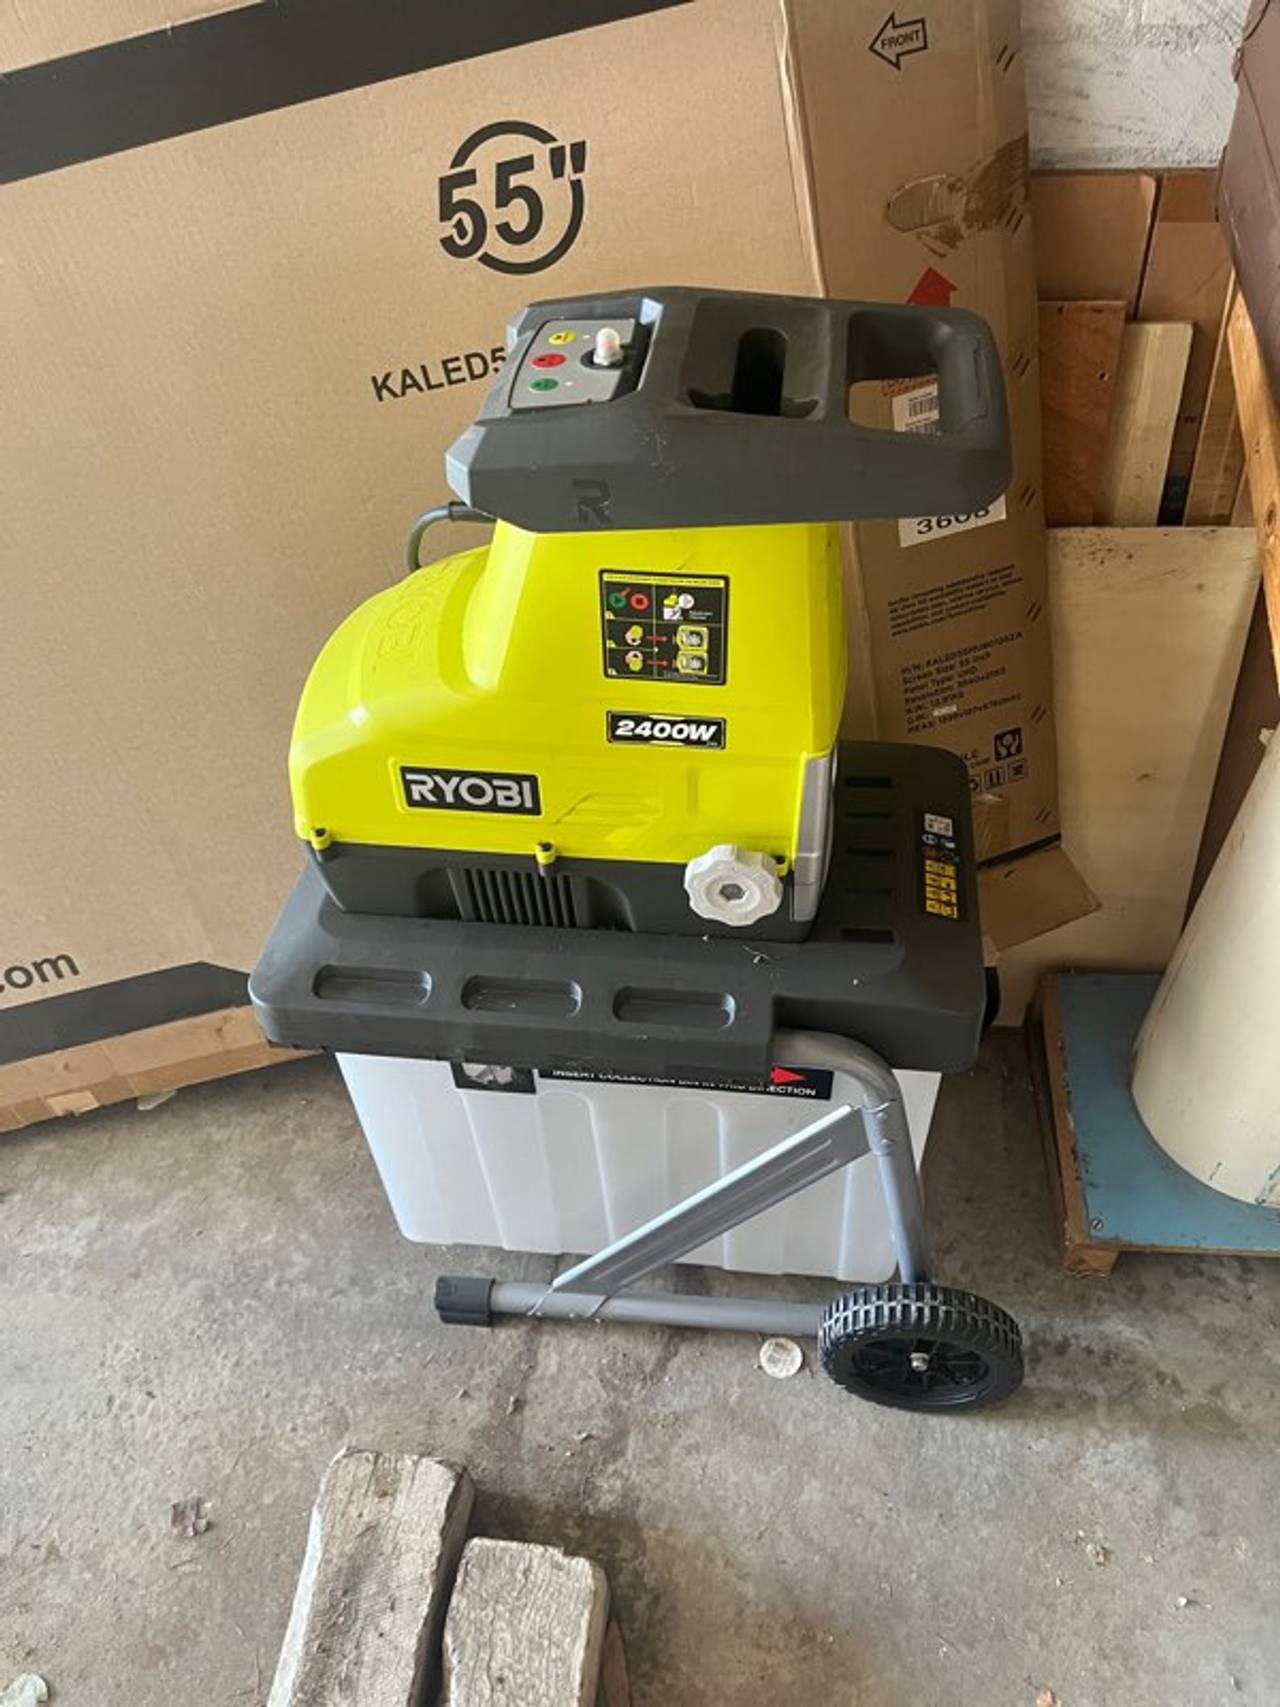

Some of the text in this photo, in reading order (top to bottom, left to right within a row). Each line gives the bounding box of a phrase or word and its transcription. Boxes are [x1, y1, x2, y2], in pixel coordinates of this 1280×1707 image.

[881, 30, 920, 49] FRONT
[439, 139, 586, 258] 55"
[614, 718, 718, 741] 2400W
[404, 772, 533, 808] RYOBI
